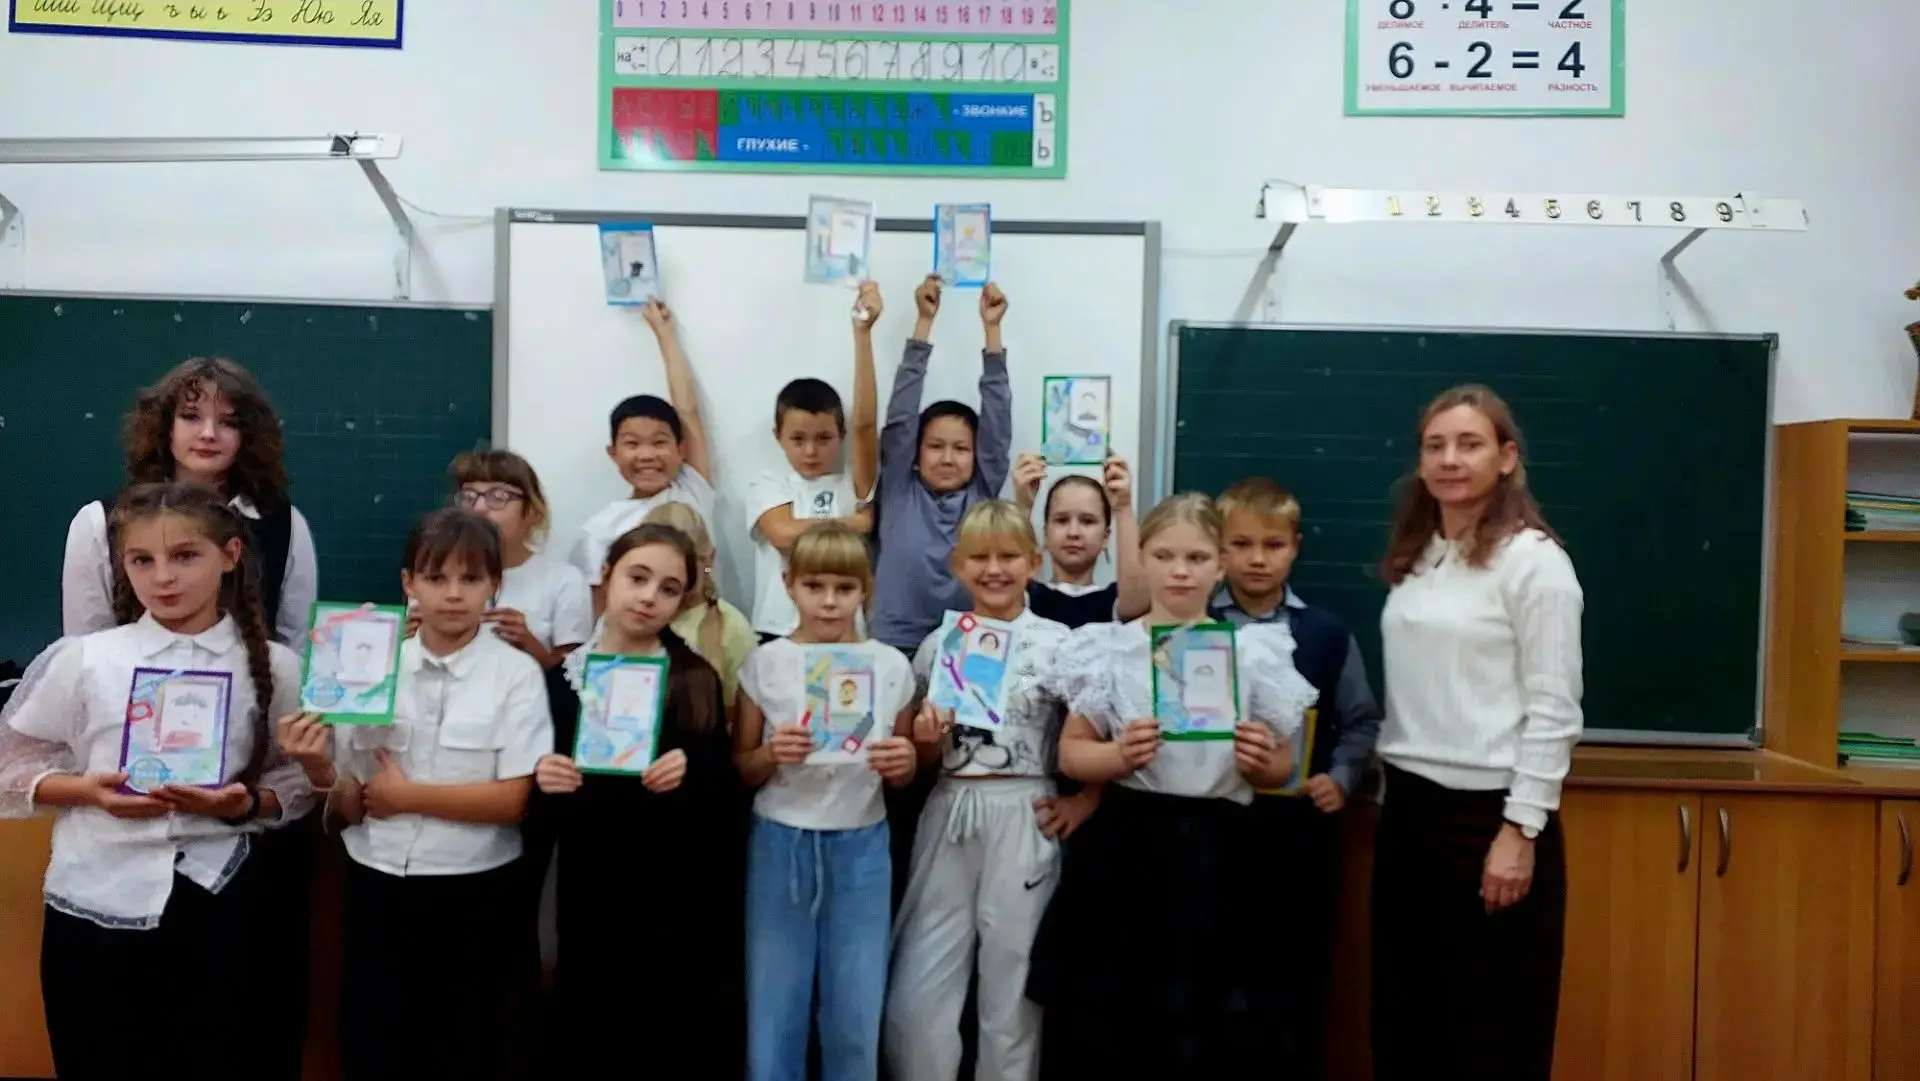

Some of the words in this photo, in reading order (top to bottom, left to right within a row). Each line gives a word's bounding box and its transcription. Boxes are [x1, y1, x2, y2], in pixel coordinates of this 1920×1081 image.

[291, 0, 335, 25] Юю
[351, 0, 384, 26] Яя
[616, 0, 623, 17] 0
[638, 0, 644, 17] 1
[660, 0, 667, 18] 2
[681, 0, 688, 18] 3
[701, 1, 709, 19] 4
[722, 1, 729, 20] 5
[745, 2, 752, 20] 6
[765, 2, 772, 20] 7
[787, 2, 795, 20] 8
[809, 2, 816, 20] 9
[828, 3, 840, 21] 10
[850, 4, 862, 21] 11
[872, 4, 884, 22] 12
[892, 5, 905, 22] 13
[914, 5, 927, 22] 14
[936, 5, 949, 23] 15
[958, 6, 970, 23] 16
[978, 6, 991, 23] 17
[1043, 6, 1057, 24] 20
[1457, 20, 1510, 29] ДЕЛИТЕЛЬ
[1548, 20, 1593, 29] ЧАСТНОЕ
[656, 36, 680, 76] 0
[695, 37, 712, 77] 1
[718, 37, 743, 77] 2
[754, 38, 774, 78] 3
[784, 39, 805, 79] 4
[816, 40, 837, 79] 5
[844, 39, 864, 79] 6
[879, 40, 900, 80] 7
[910, 41, 931, 81] 8
[942, 41, 963, 81] 9
[978, 42, 1026, 82] 10
[1388, 41, 1415, 79] 6
[1465, 41, 1492, 78] 2
[1557, 41, 1586, 78] 4
[1548, 83, 1599, 92] РАЗНОСТЬ
[961, 104, 1030, 119] ЗВОНКИЕ
[736, 137, 799, 153] ГЛУХИЕ
[1387, 194, 1404, 217] 1
[1425, 195, 1443, 217] 2
[1468, 196, 1484, 217] 3
[1504, 197, 1521, 218] 4
[1544, 198, 1561, 219] 5
[1586, 199, 1603, 220] 6
[1626, 201, 1642, 222] 7
[1669, 201, 1686, 223] 8
[1716, 202, 1733, 223] 9
